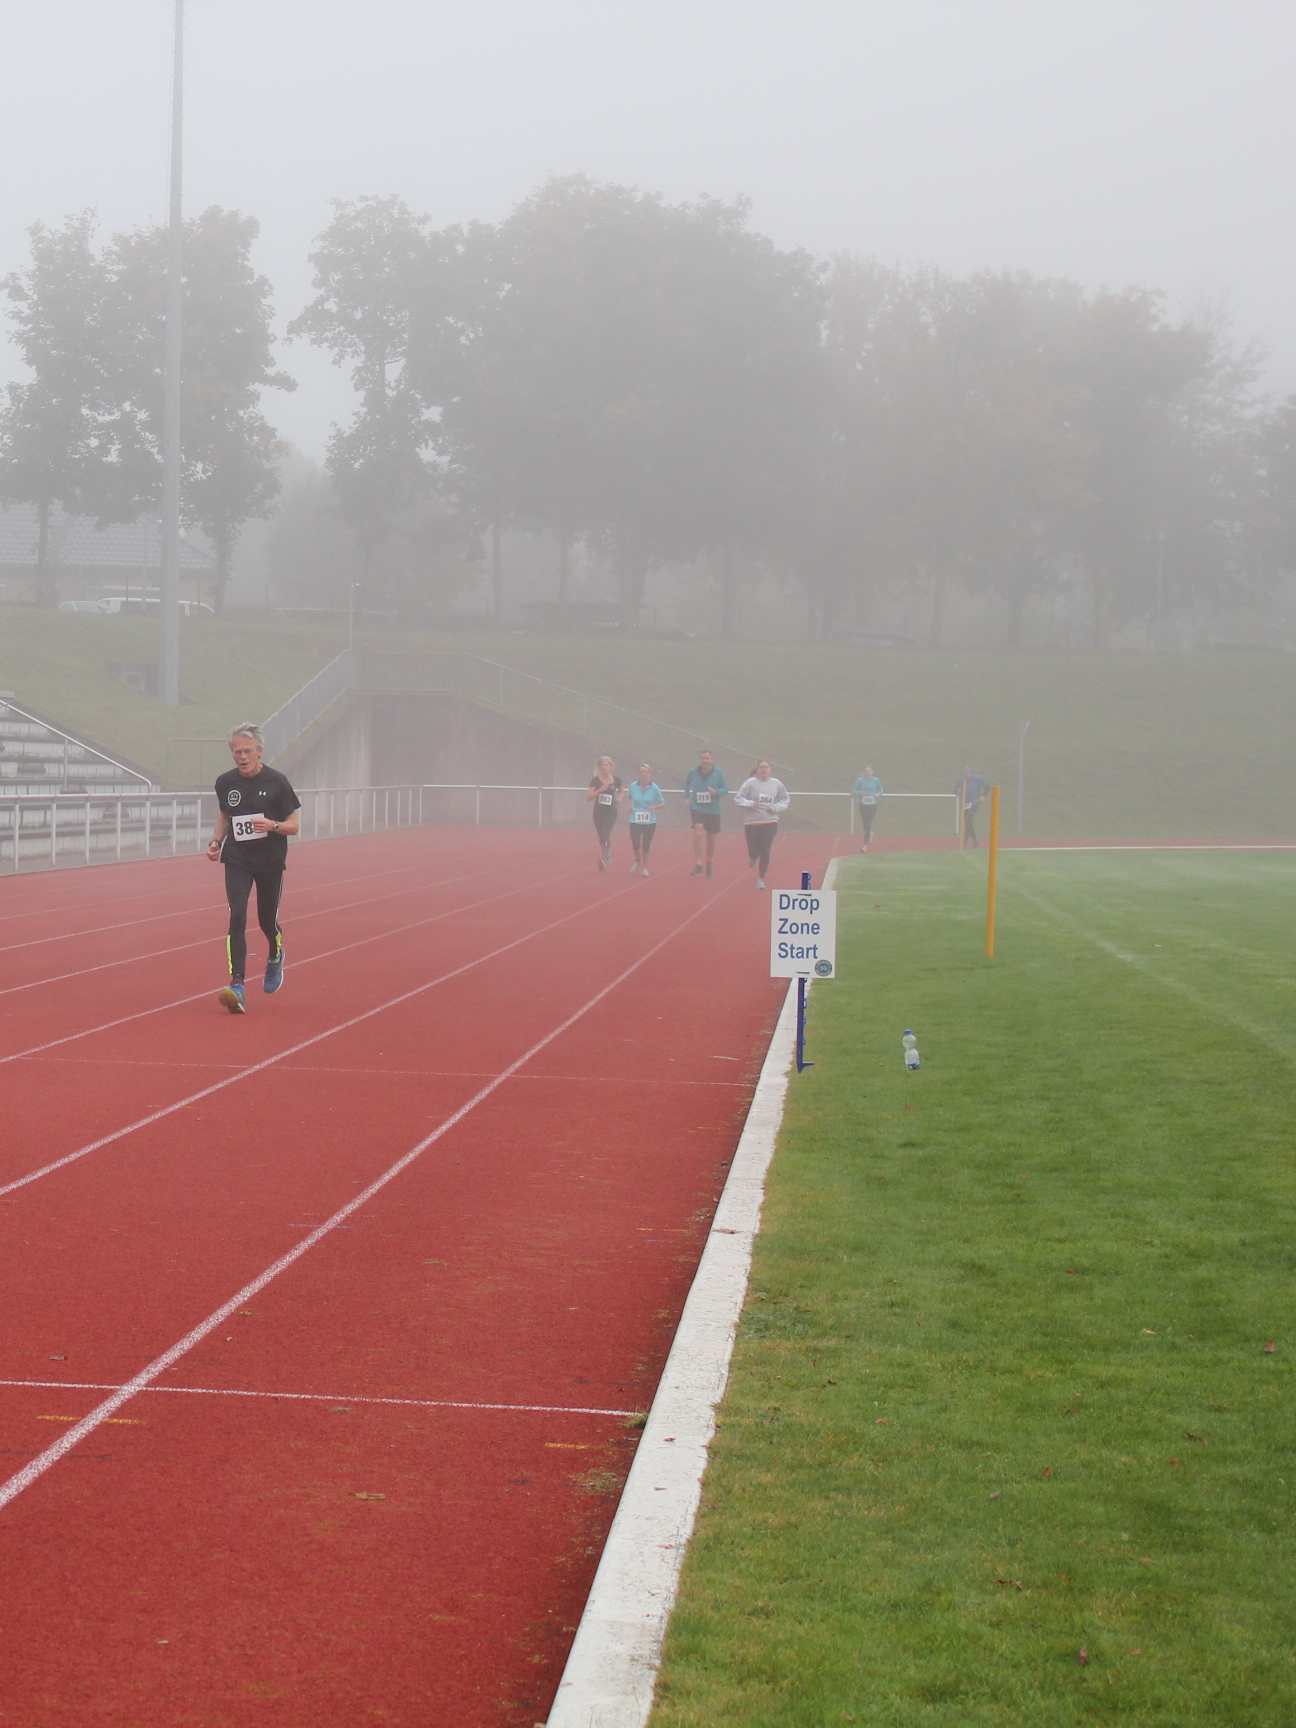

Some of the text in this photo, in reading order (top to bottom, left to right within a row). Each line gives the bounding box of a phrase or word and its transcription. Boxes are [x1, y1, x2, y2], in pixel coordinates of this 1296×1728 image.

[236, 821, 255, 836] 38
[779, 893, 820, 914] Drop
[777, 918, 820, 935] Zone
[777, 942, 818, 959] Start
